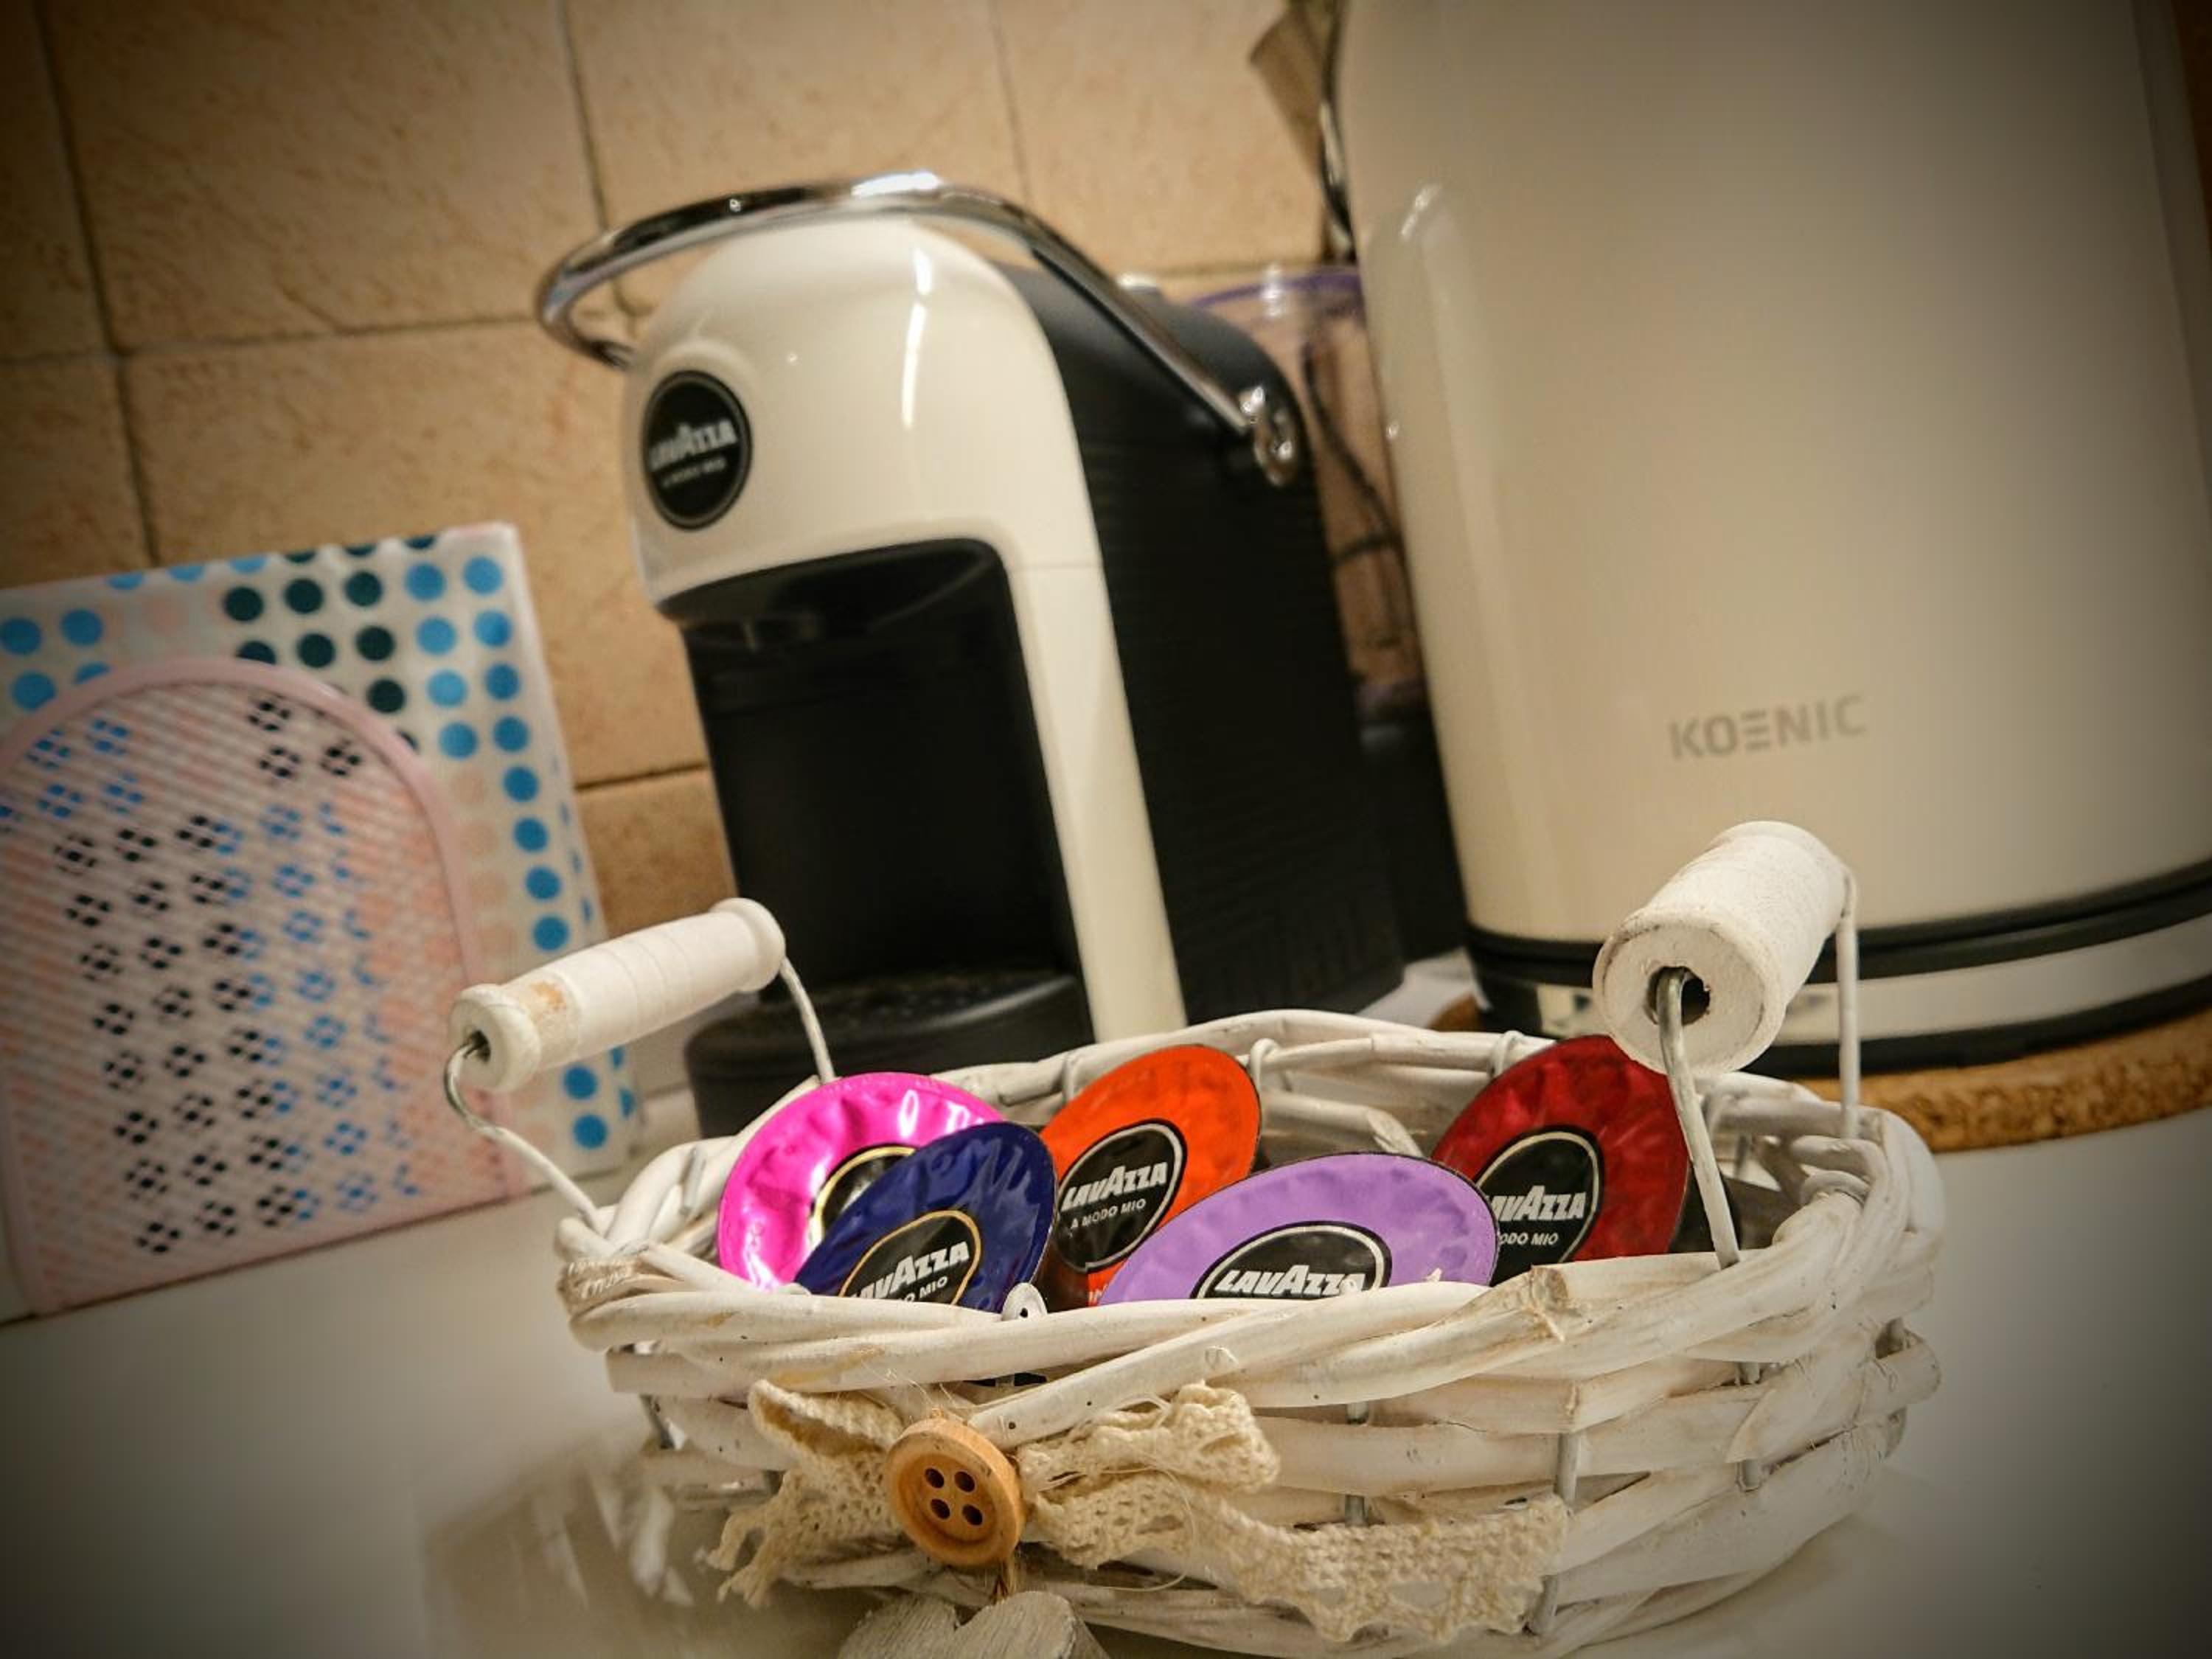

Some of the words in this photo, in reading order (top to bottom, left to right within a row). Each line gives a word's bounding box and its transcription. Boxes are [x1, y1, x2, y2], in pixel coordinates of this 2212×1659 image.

[649, 419, 737, 472] AZZA
[1668, 694, 1867, 759] KOENIC
[1060, 1161, 1168, 1211] LAVAZZA
[1485, 1185, 1586, 1222] AVAZZA
[1071, 1217, 1079, 1229] A
[1082, 1206, 1119, 1227] MODO
[1121, 1198, 1147, 1214] MIO
[1499, 1232, 1528, 1245] ODO
[1531, 1232, 1559, 1245] MIO
[850, 1241, 970, 1298] AVAZZA
[919, 1276, 948, 1298] MIO
